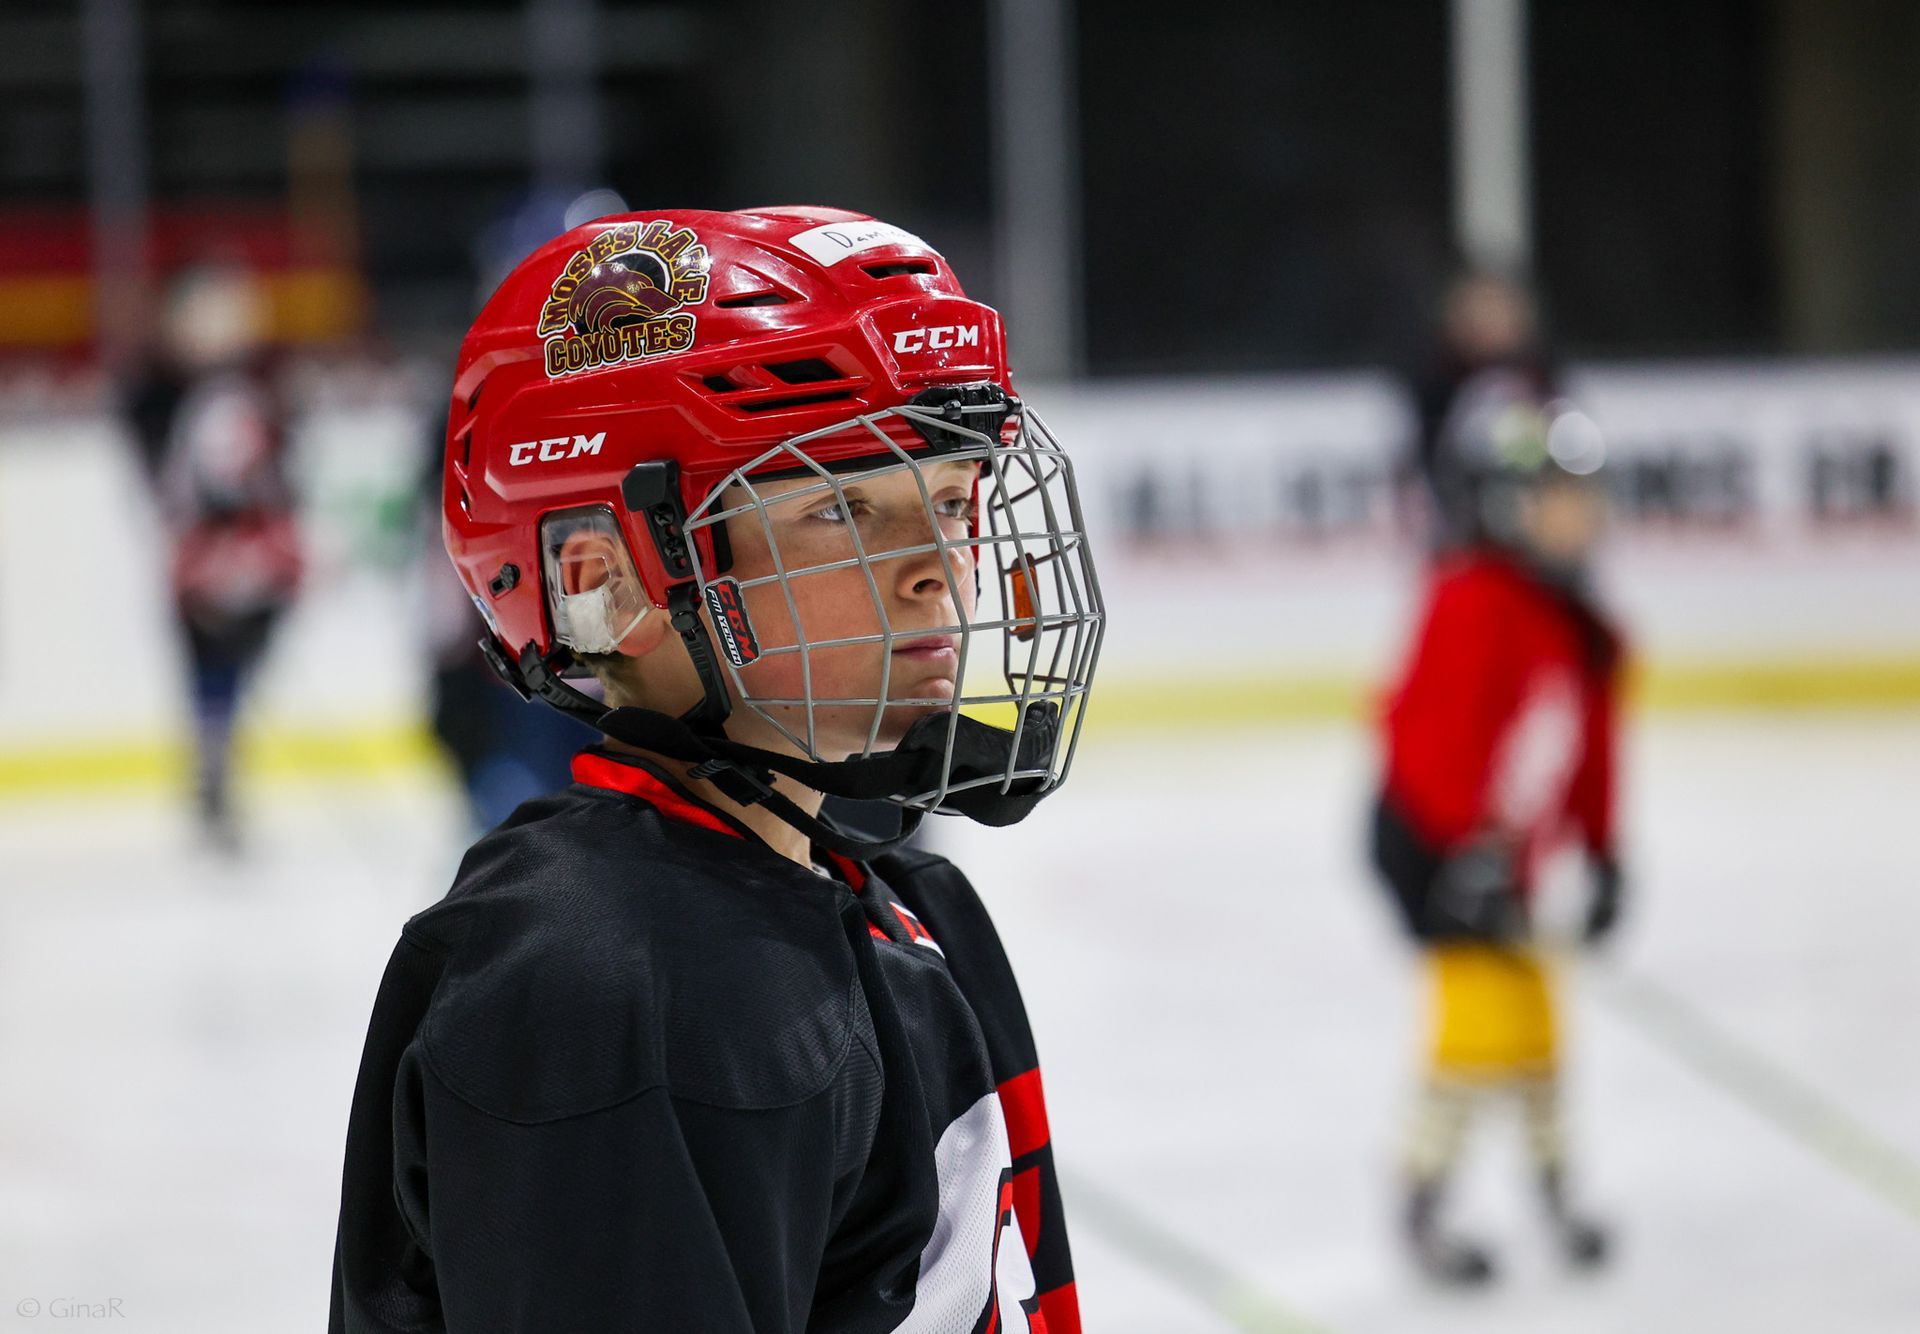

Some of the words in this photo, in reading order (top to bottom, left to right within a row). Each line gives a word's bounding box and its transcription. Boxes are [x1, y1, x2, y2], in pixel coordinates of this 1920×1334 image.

[541, 223, 639, 333] MOSES
[638, 221, 707, 301] LAKE
[547, 316, 693, 375] COYOTES
[892, 324, 980, 354] CCM
[509, 431, 607, 467] CCM
[716, 583, 756, 659] CCM
